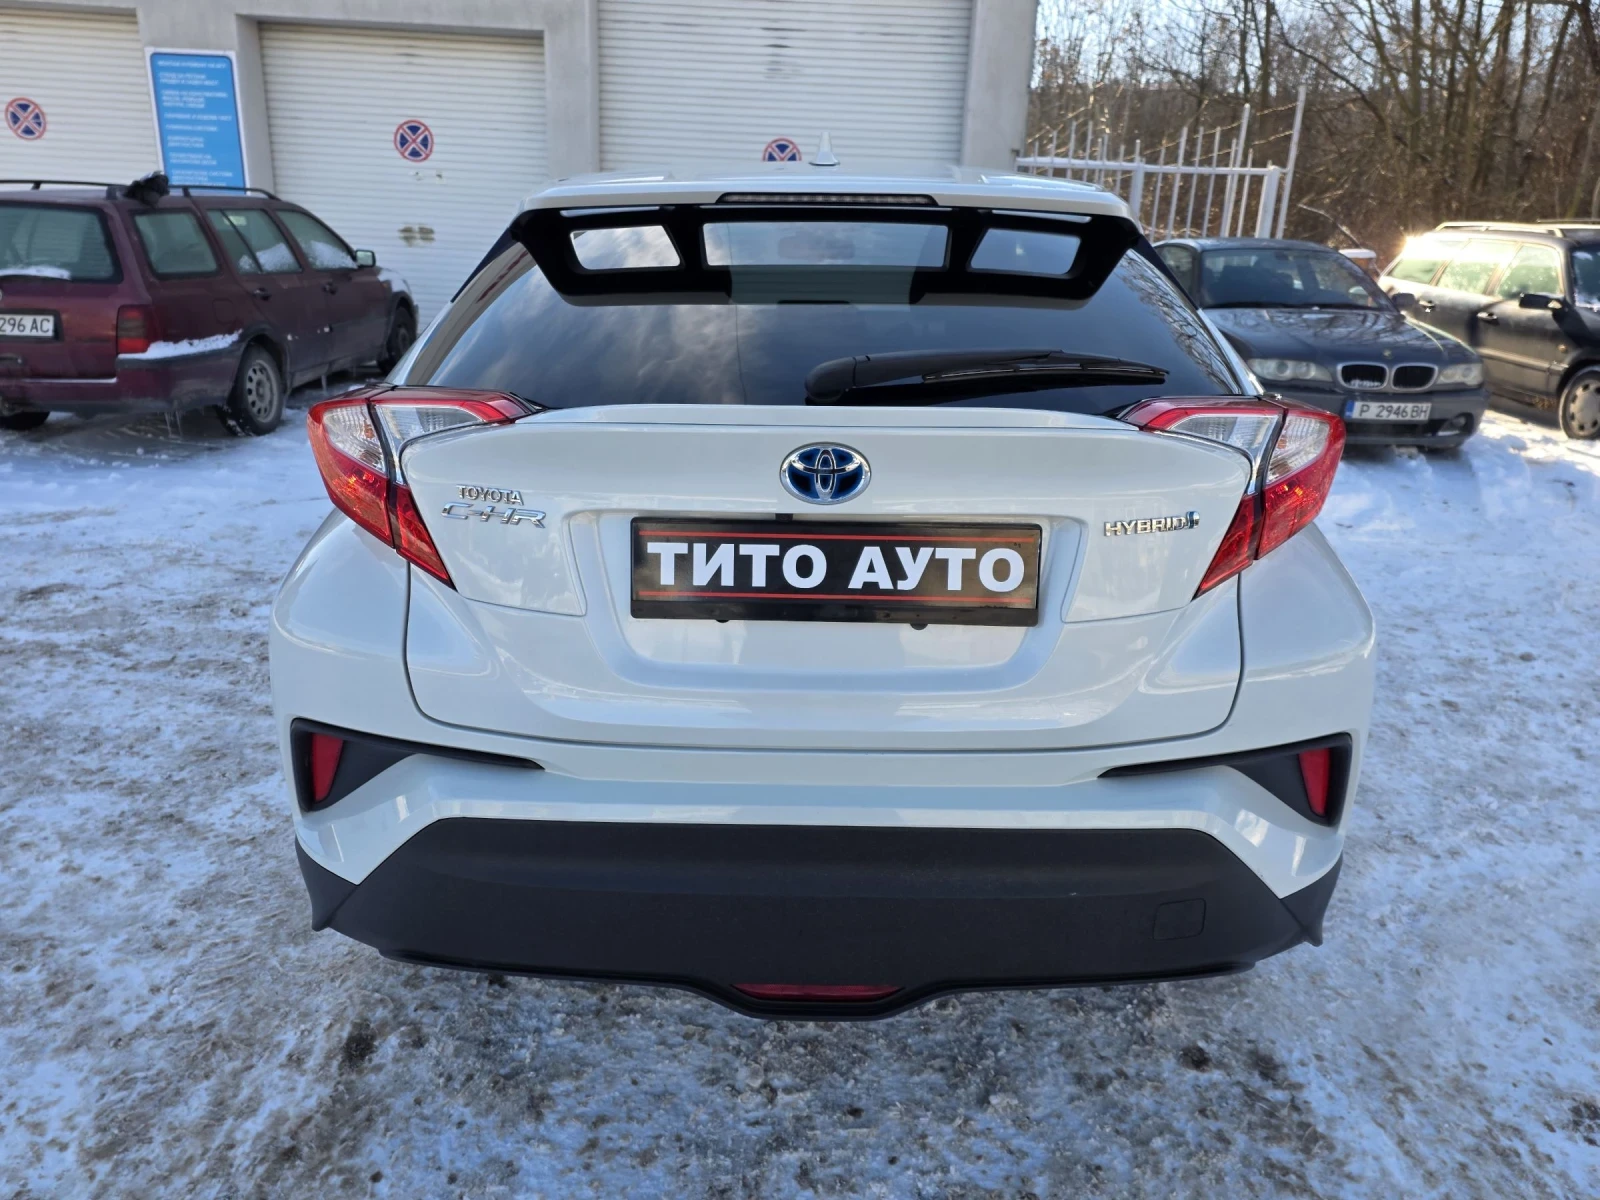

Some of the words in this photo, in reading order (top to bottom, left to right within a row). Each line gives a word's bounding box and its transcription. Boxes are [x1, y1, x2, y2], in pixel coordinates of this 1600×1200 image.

[30, 317, 51, 333] AC
[1359, 404, 1371, 417] P
[1376, 405, 1408, 418] 2946
[456, 484, 524, 506] TOYOTA
[441, 501, 546, 528] C-HR
[1104, 515, 1186, 536] HYBRID
[646, 542, 827, 589] ТИТО
[847, 546, 1025, 592] АУТО
